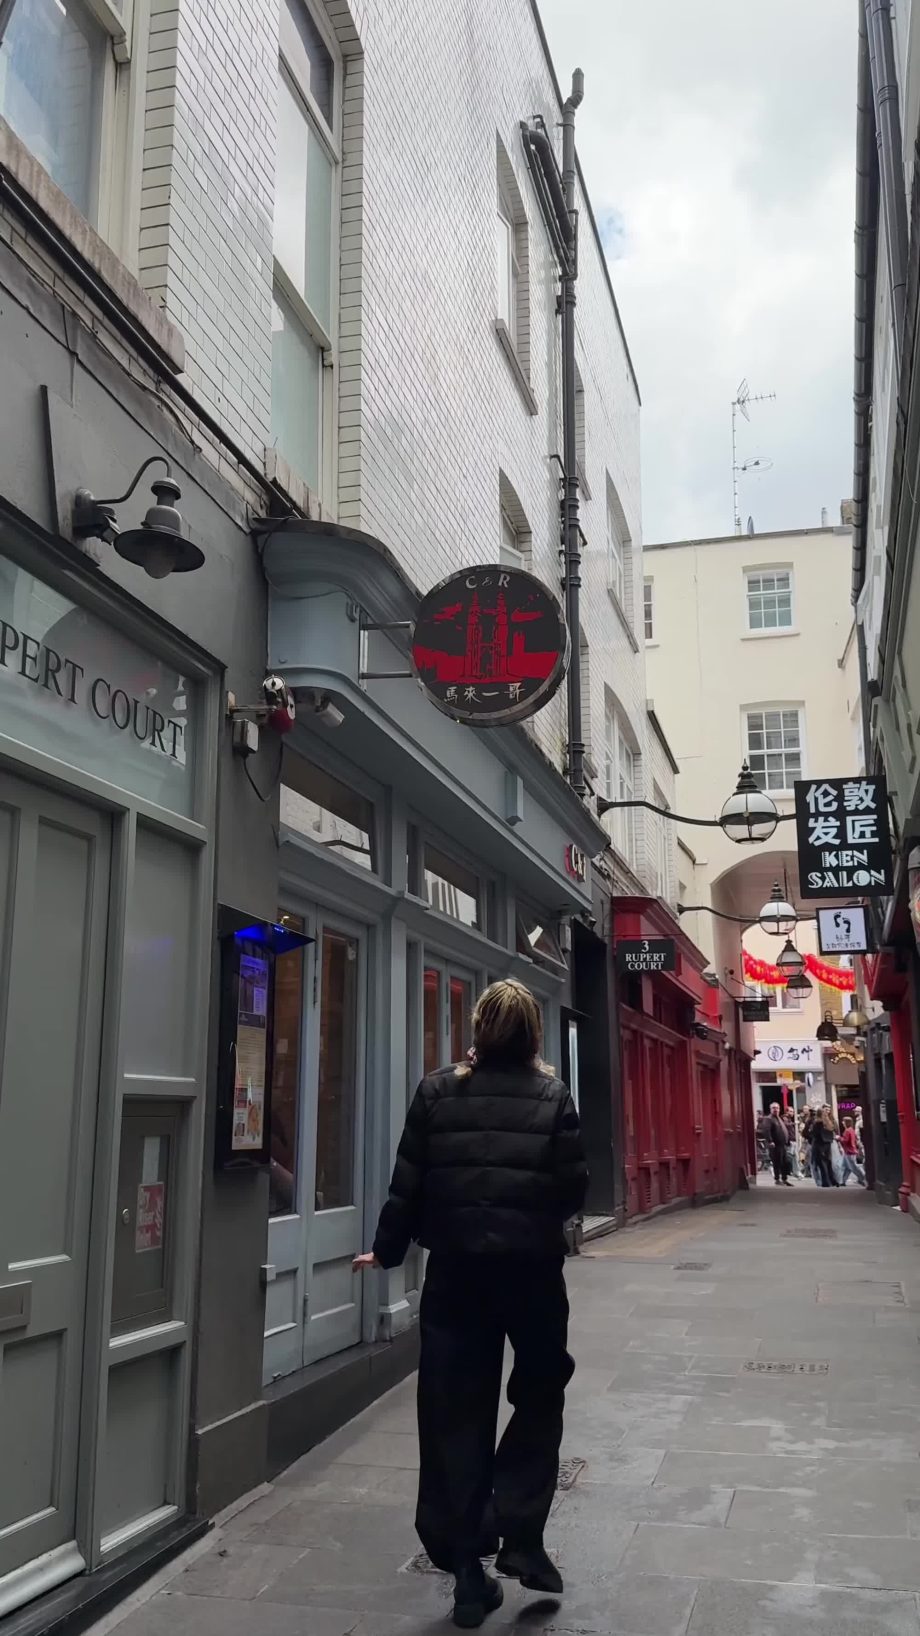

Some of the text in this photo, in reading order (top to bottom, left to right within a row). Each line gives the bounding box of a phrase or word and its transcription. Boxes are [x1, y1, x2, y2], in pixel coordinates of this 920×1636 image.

[444, 683, 525, 702] 馬來一哥
[91, 678, 182, 759] COURT
[806, 781, 876, 813] 伦敦
[808, 815, 879, 846] 发匠
[821, 850, 869, 868] KEN
[808, 870, 885, 888] SALON
[641, 940, 649, 952] 3
[625, 953, 666, 962] RUPERT
[627, 962, 664, 970] COURT
